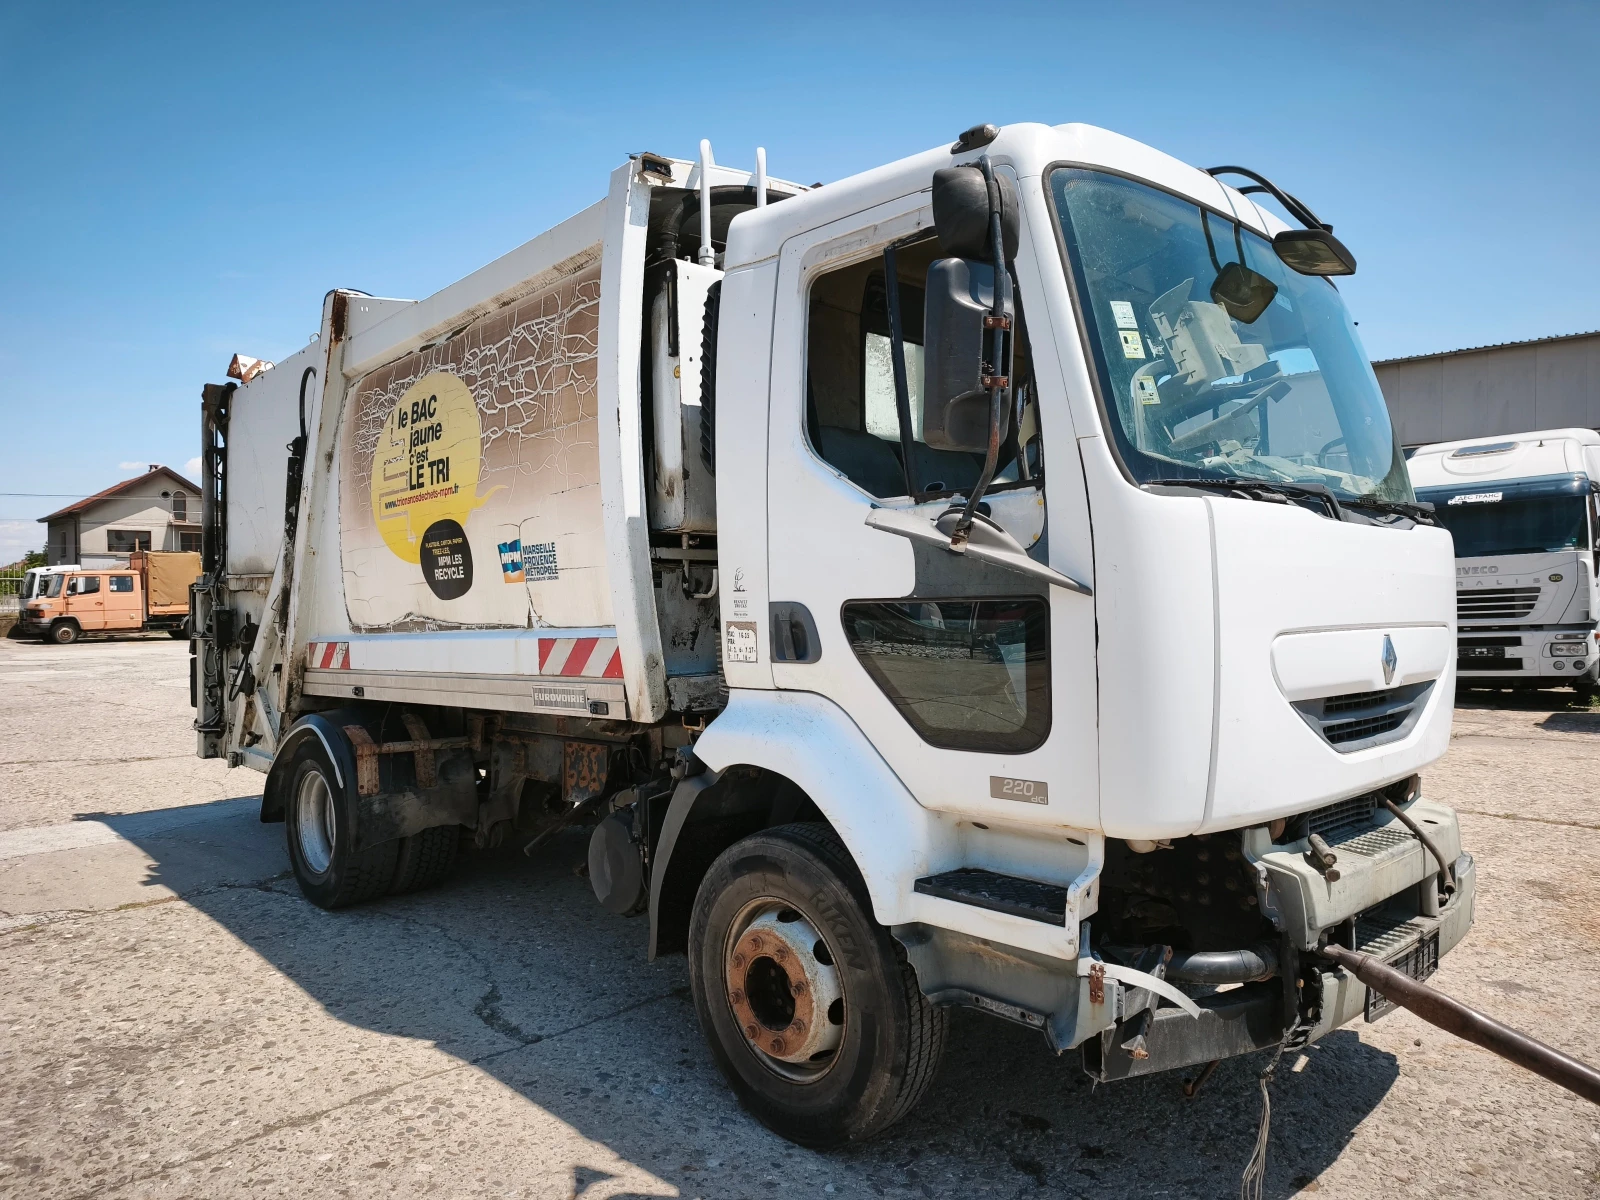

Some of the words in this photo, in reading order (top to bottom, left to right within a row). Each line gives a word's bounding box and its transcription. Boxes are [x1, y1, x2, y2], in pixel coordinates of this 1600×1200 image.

[398, 408, 408, 429] le
[411, 394, 437, 425] BAC
[409, 422, 442, 453] jaune
[409, 446, 429, 466] c'est
[409, 464, 425, 491] LE
[428, 456, 450, 486] TRI
[522, 542, 556, 555] MARSEILLE
[438, 555, 452, 567] MPM
[451, 554, 463, 565] LES
[500, 551, 521, 564] MPM
[524, 553, 558, 566] PROVENCE
[434, 566, 465, 580] RECYCLE
[1456, 565, 1499, 575] IVECO
[534, 692, 585, 703] EUROVOIRIE
[1002, 779, 1034, 796] 220
[809, 888, 867, 971] RIKEN
